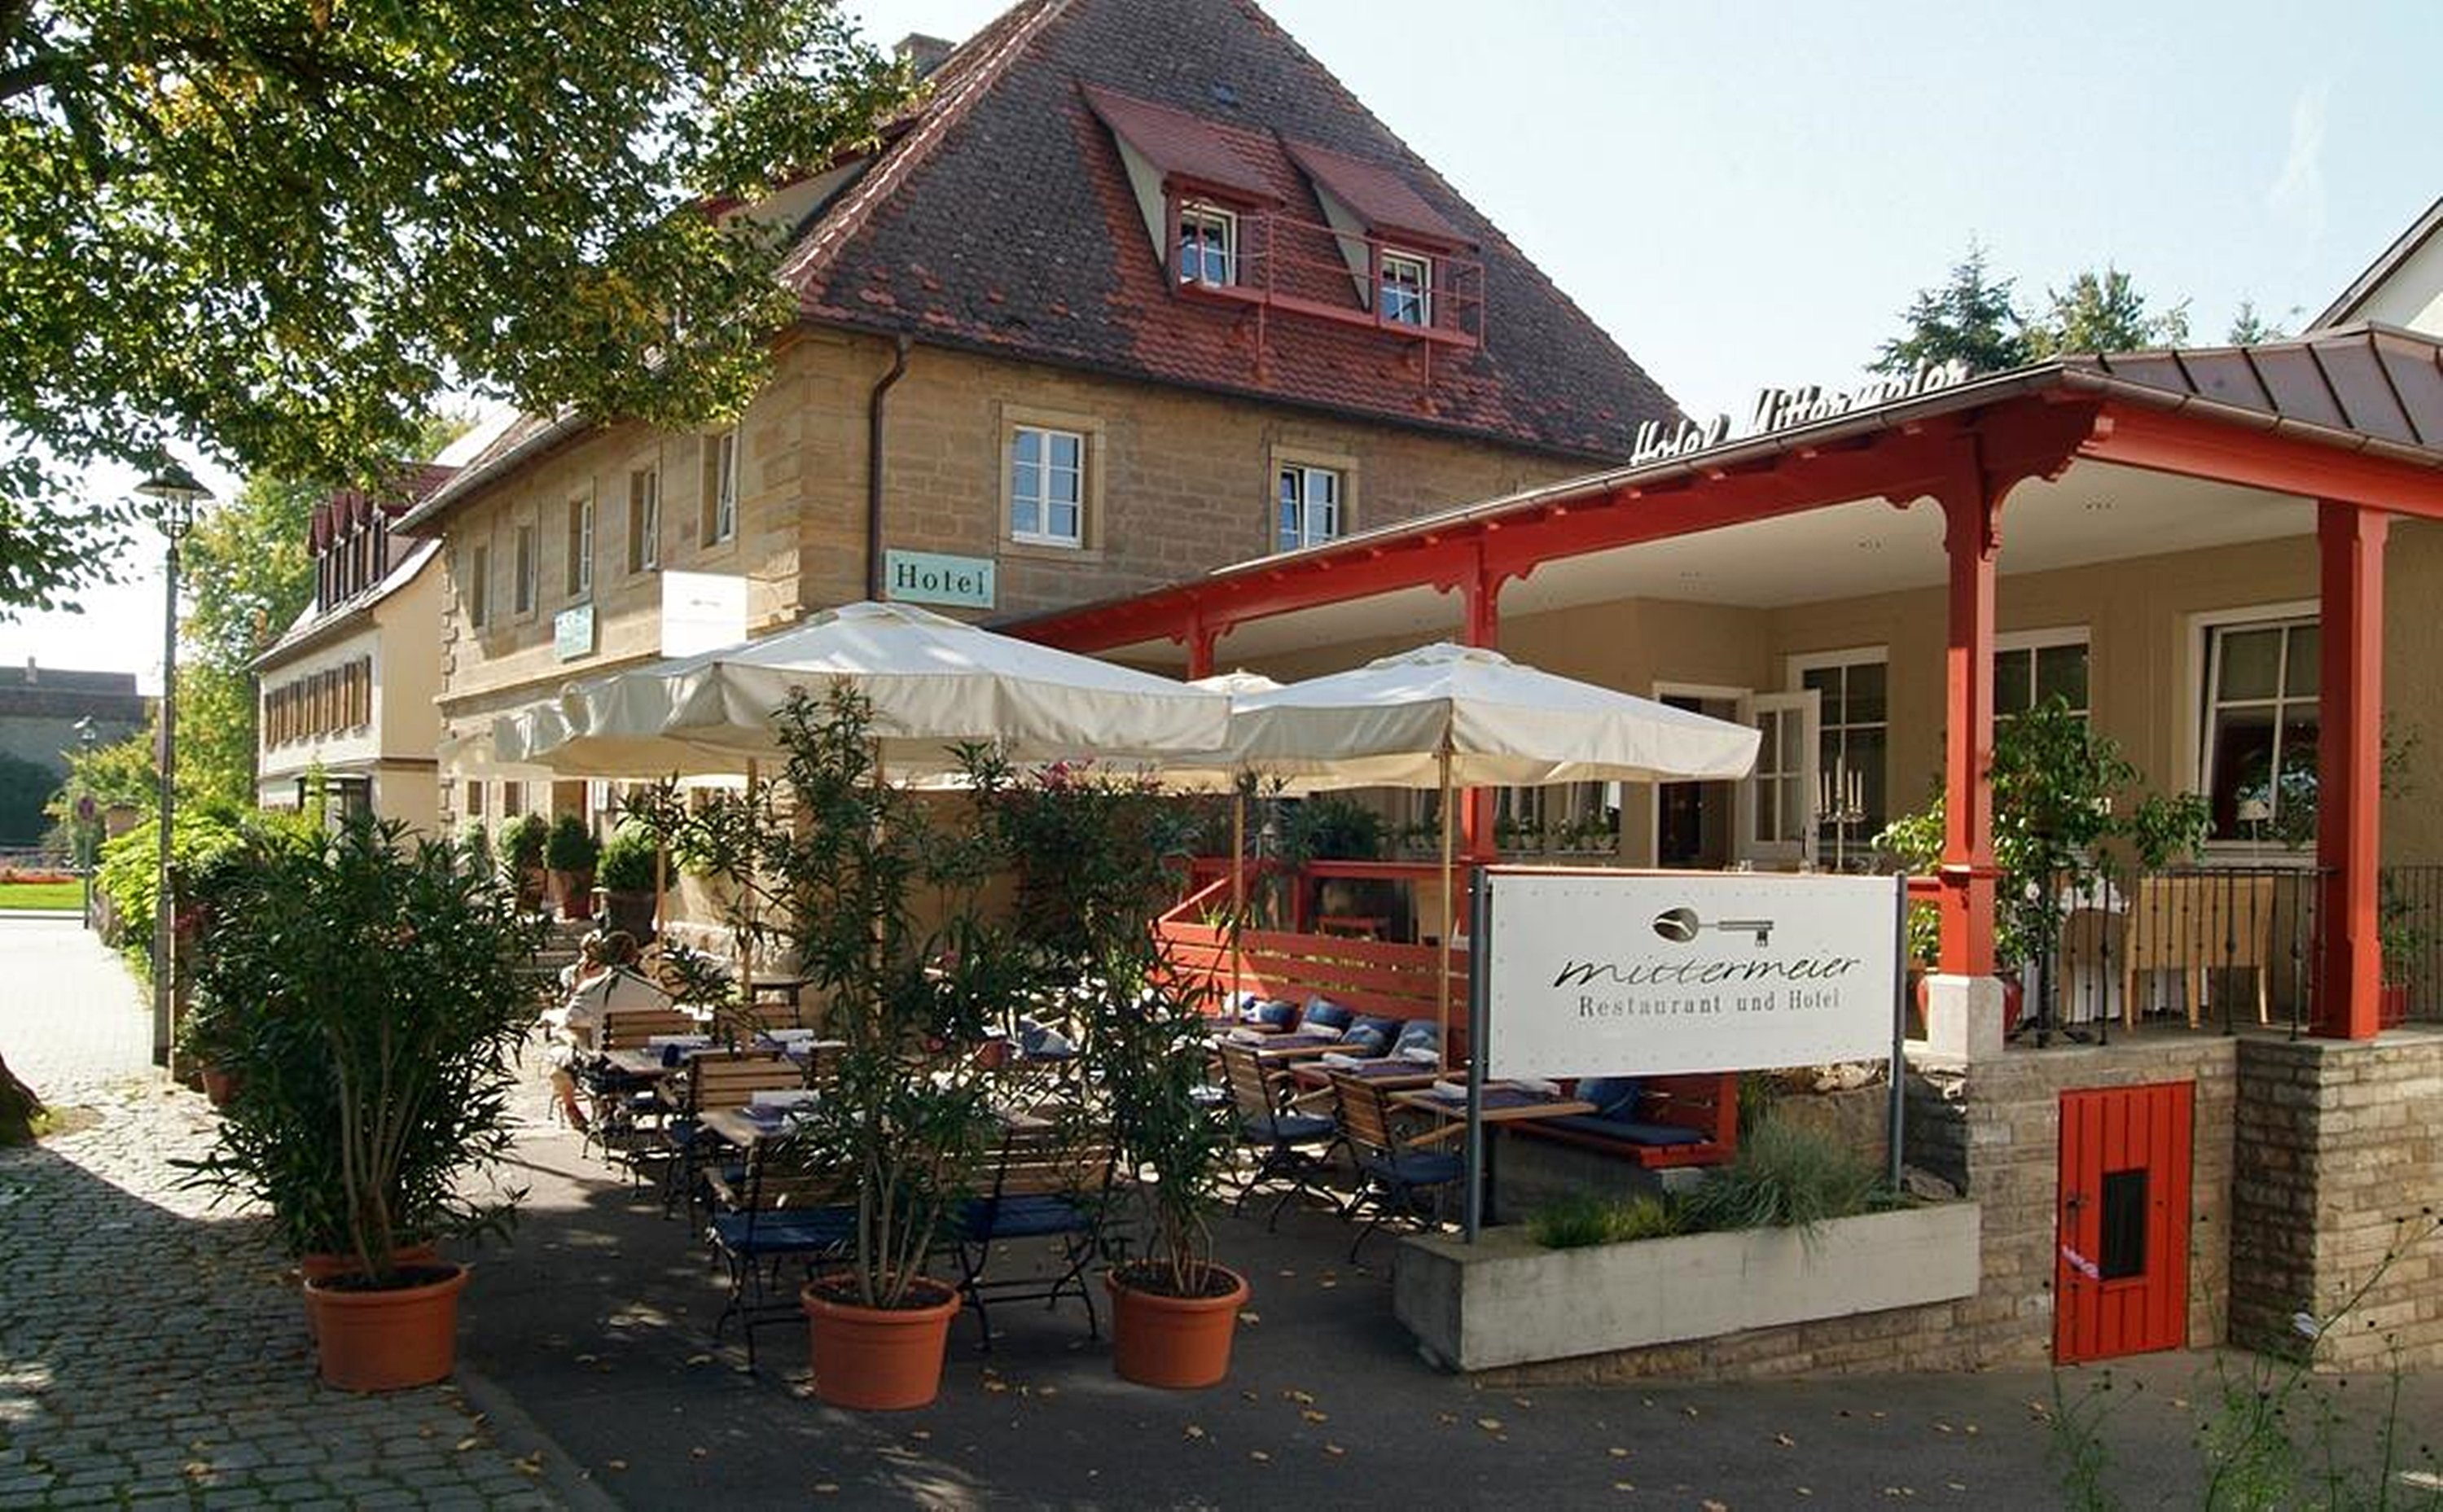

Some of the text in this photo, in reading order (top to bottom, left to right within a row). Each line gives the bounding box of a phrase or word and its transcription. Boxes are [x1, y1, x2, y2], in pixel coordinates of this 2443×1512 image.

[897, 563, 984, 595] Hotel
[1554, 955, 1861, 988] mittermeier
[1579, 987, 1840, 1018] Restaurant und Hotel
